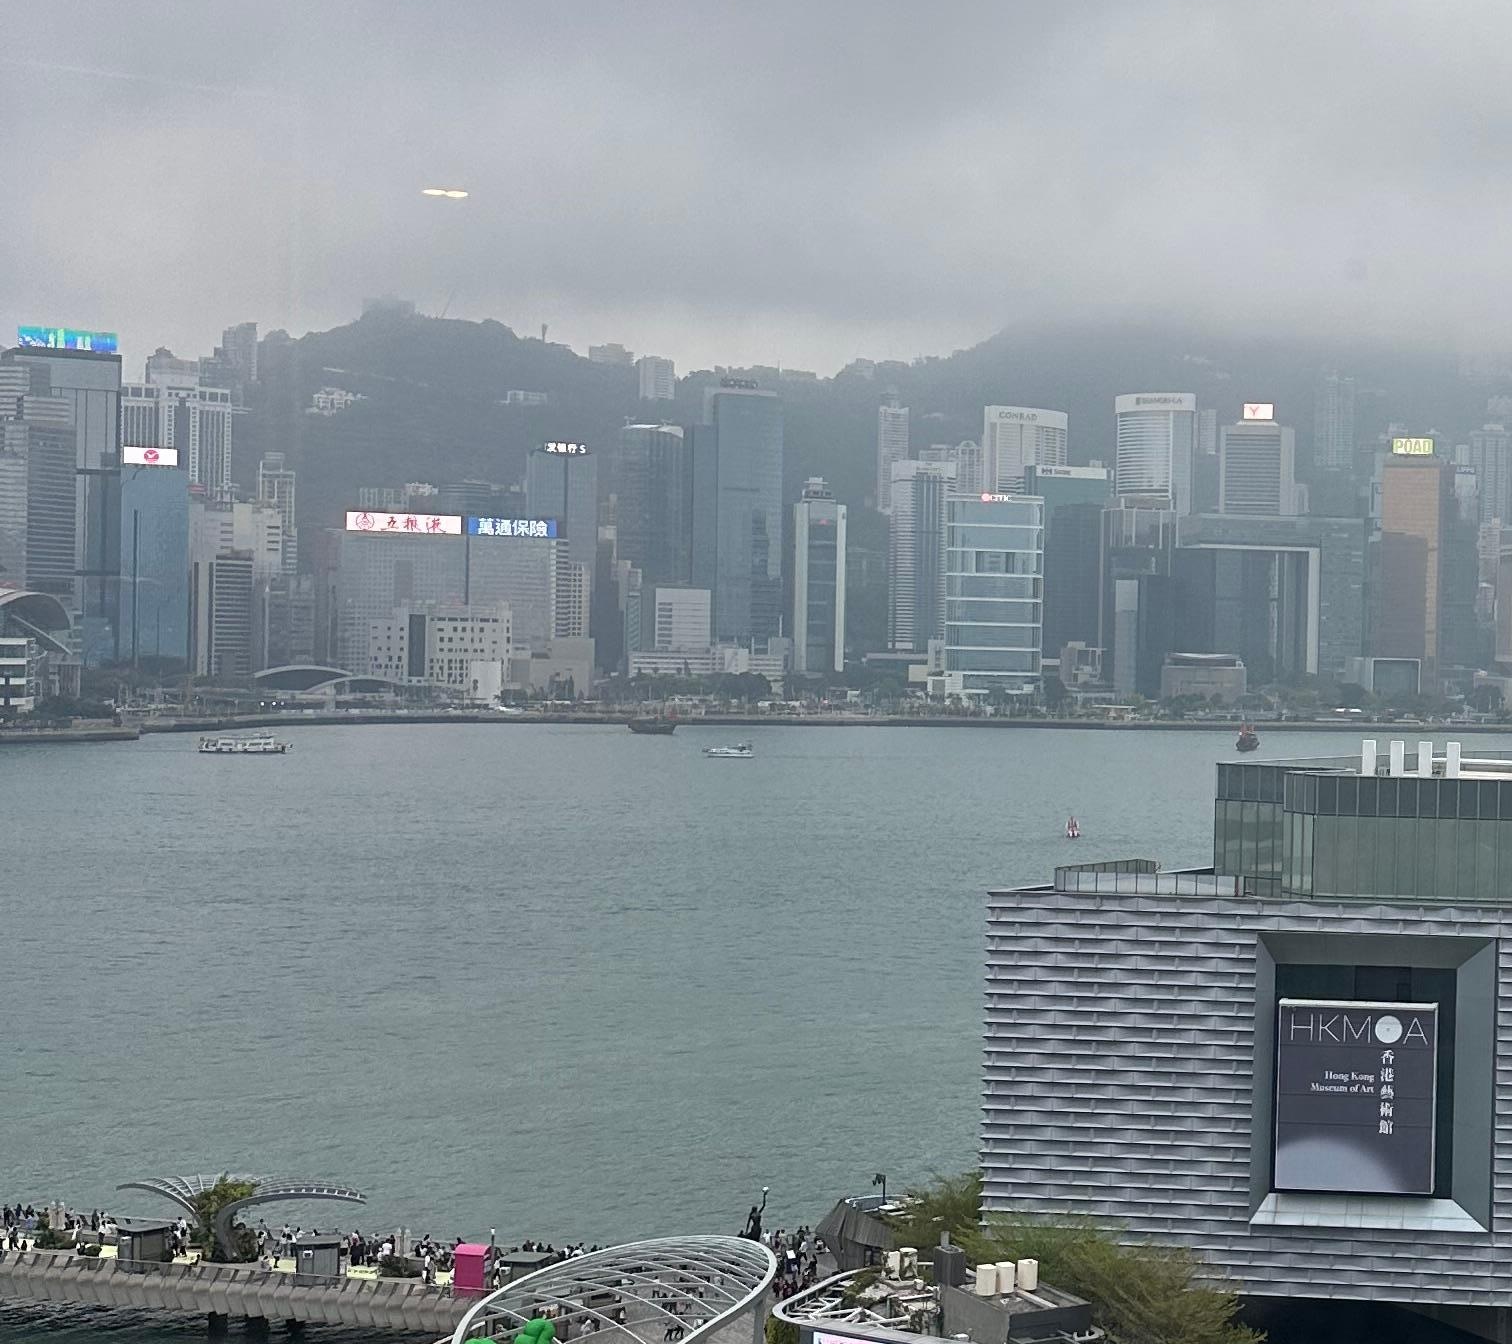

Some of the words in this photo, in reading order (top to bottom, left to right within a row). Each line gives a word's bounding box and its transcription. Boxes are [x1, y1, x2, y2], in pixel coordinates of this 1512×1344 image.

[1395, 439, 1431, 453] POAD
[478, 517, 548, 536] 萬通保險
[1289, 1012, 1429, 1046] HKMOA
[1324, 1070, 1350, 1083] Hong
[1351, 1071, 1375, 1083] Kong
[1310, 1082, 1348, 1093] Museum
[1349, 1083, 1359, 1093] of
[1359, 1084, 1375, 1094] Art
[1378, 1048, 1396, 1136] 香港藝術館
